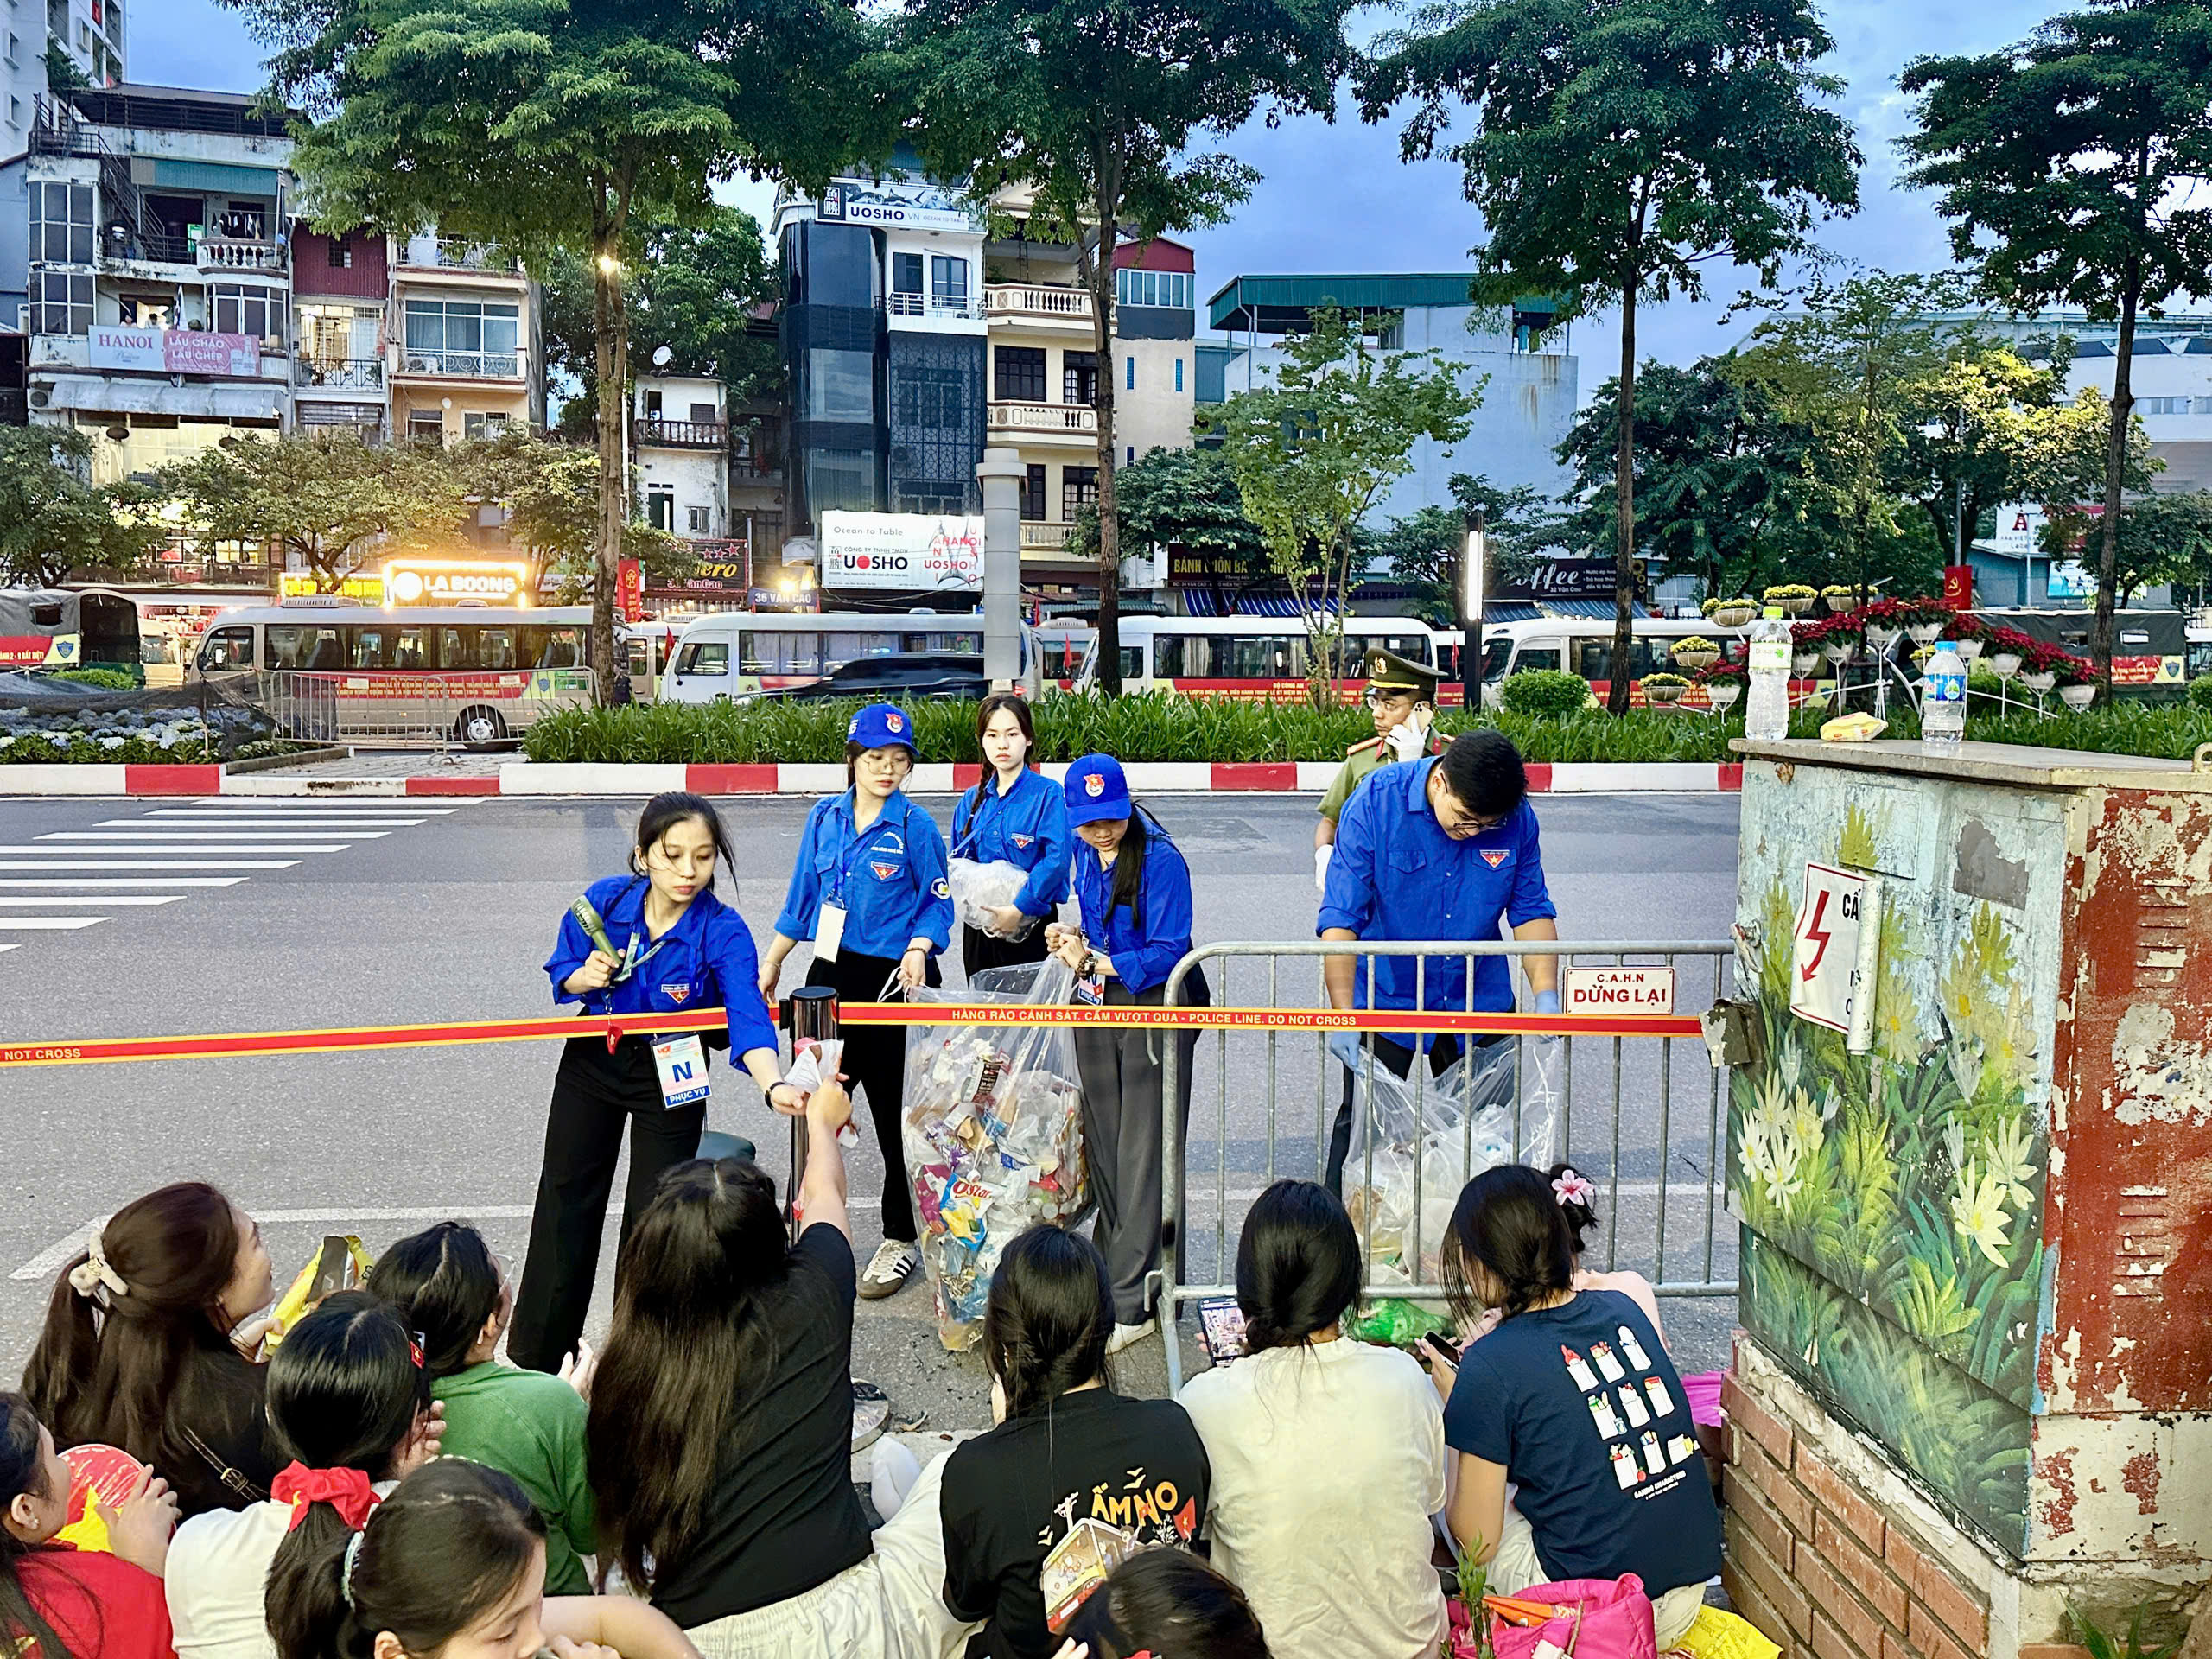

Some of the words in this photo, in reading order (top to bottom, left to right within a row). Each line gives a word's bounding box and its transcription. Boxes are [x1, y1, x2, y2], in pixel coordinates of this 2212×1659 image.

[850, 207, 905, 220] UOSHO
[98, 334, 153, 349] HANOI
[834, 526, 863, 535] Ocean
[425, 576, 449, 591] LA
[1507, 564, 1580, 590] offee
[755, 593, 767, 602] 36
[792, 594, 811, 603] CAO
[1842, 888, 1861, 921] CẤ
[1597, 974, 1644, 982] C.A.H.N
[1574, 984, 1629, 1003] DỪNG
[1634, 989, 1666, 1006] LẠI
[952, 1007, 986, 1020] HÀNG
[990, 1007, 1016, 1020] RÀO
[1153, 1012, 1178, 1023] QUA
[1189, 1013, 1231, 1023] POLICE
[1235, 1014, 1265, 1024] LINE.
[1268, 1015, 1286, 1024] DO
[1289, 1015, 1313, 1025] NOT
[1316, 1016, 1356, 1026] CROSS
[4, 1050, 32, 1060] NOT
[35, 1048, 81, 1059] CROSS
[672, 1061, 693, 1083] N
[669, 1091, 693, 1103] PHỤC
[694, 1087, 706, 1096] VỤ
